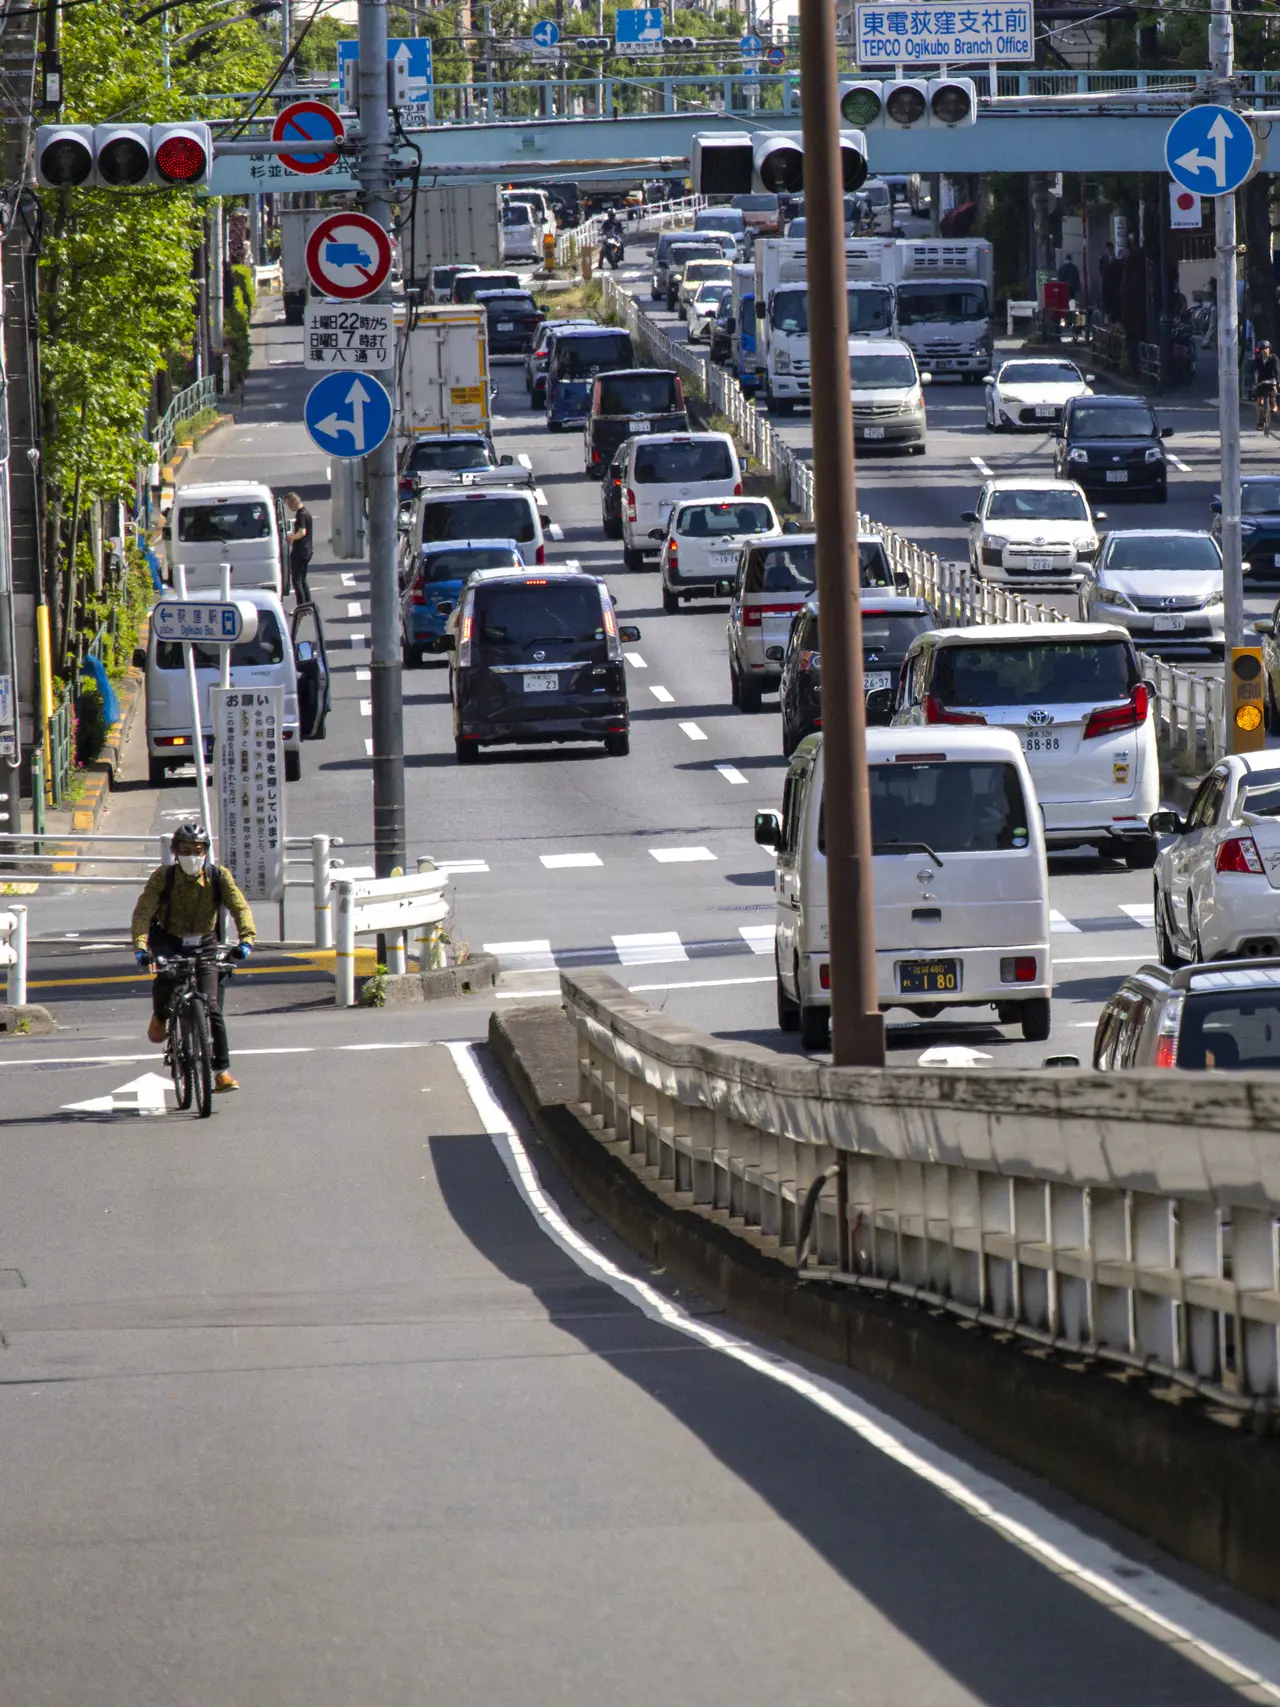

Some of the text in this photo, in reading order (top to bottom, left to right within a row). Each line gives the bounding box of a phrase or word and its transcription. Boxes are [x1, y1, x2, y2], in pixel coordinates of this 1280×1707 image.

[863, 8, 1027, 37] 東電荻窪支社前
[863, 36, 1029, 59] TEPCO Ogikubo Branch Office
[310, 312, 388, 331] 土曜日22時から
[310, 330, 387, 348] 日曜日7時まで
[310, 349, 387, 363] 環八通り
[226, 694, 270, 708] お願い
[1026, 738, 1060, 751] 88-88
